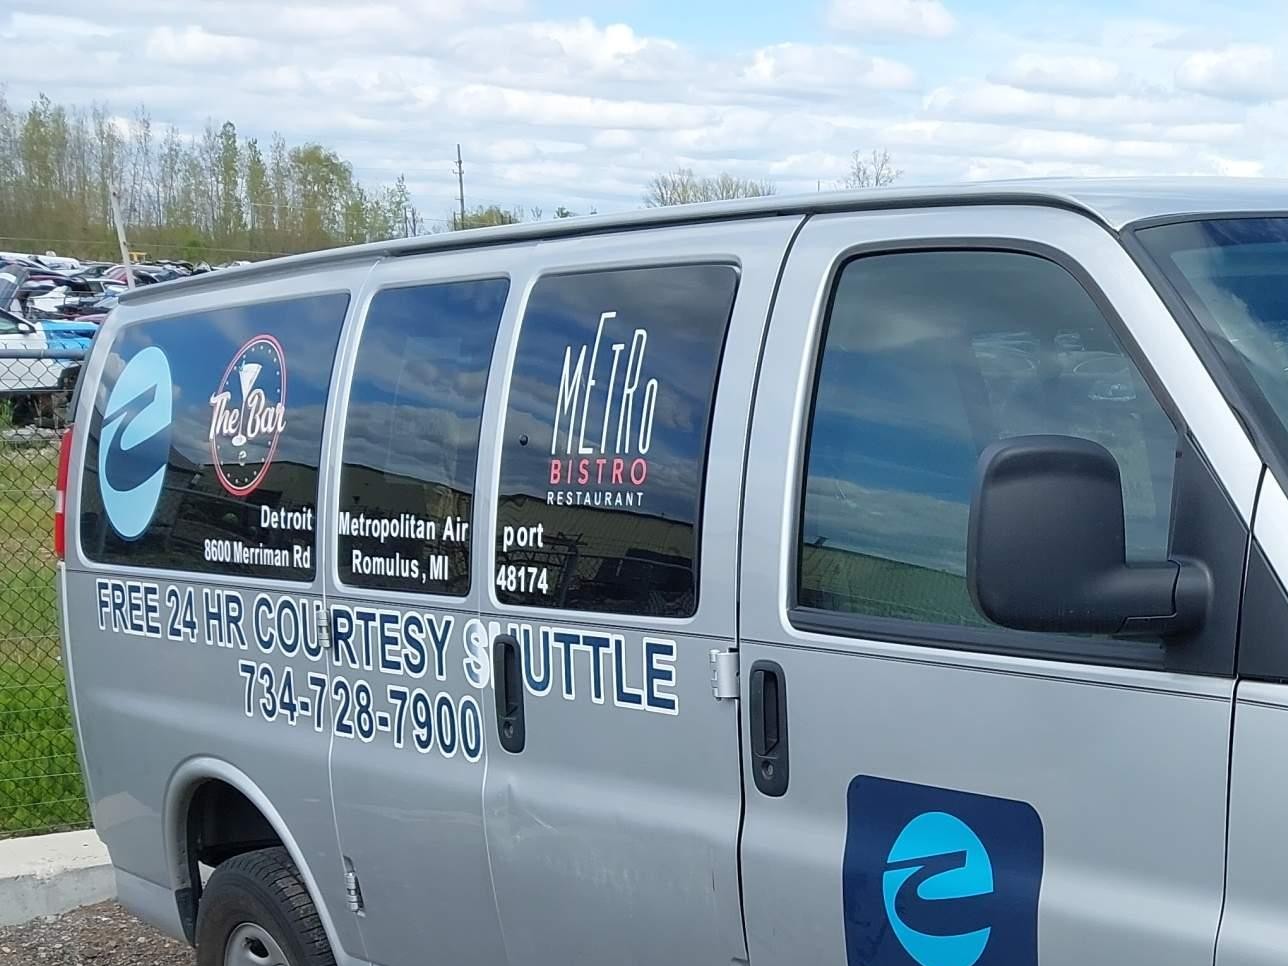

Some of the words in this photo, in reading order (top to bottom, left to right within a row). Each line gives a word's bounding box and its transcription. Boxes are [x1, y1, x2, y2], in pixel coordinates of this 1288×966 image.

[209, 391, 240, 440] The
[246, 388, 287, 438] Bar
[549, 457, 648, 486] BISTRO
[546, 490, 644, 507] RESTAURANT
[260, 504, 313, 531] Detroit
[338, 510, 436, 543] Metropolitan
[203, 538, 232, 563] 8600
[233, 540, 289, 567] Merriman
[292, 544, 311, 569] Rd
[495, 564, 549, 595] 48174
[96, 578, 161, 638] FREE
[165, 584, 199, 643] 24
[203, 588, 248, 650] HR
[252, 593, 454, 681] COURTESY
[238, 659, 482, 763] 734-728-7900
